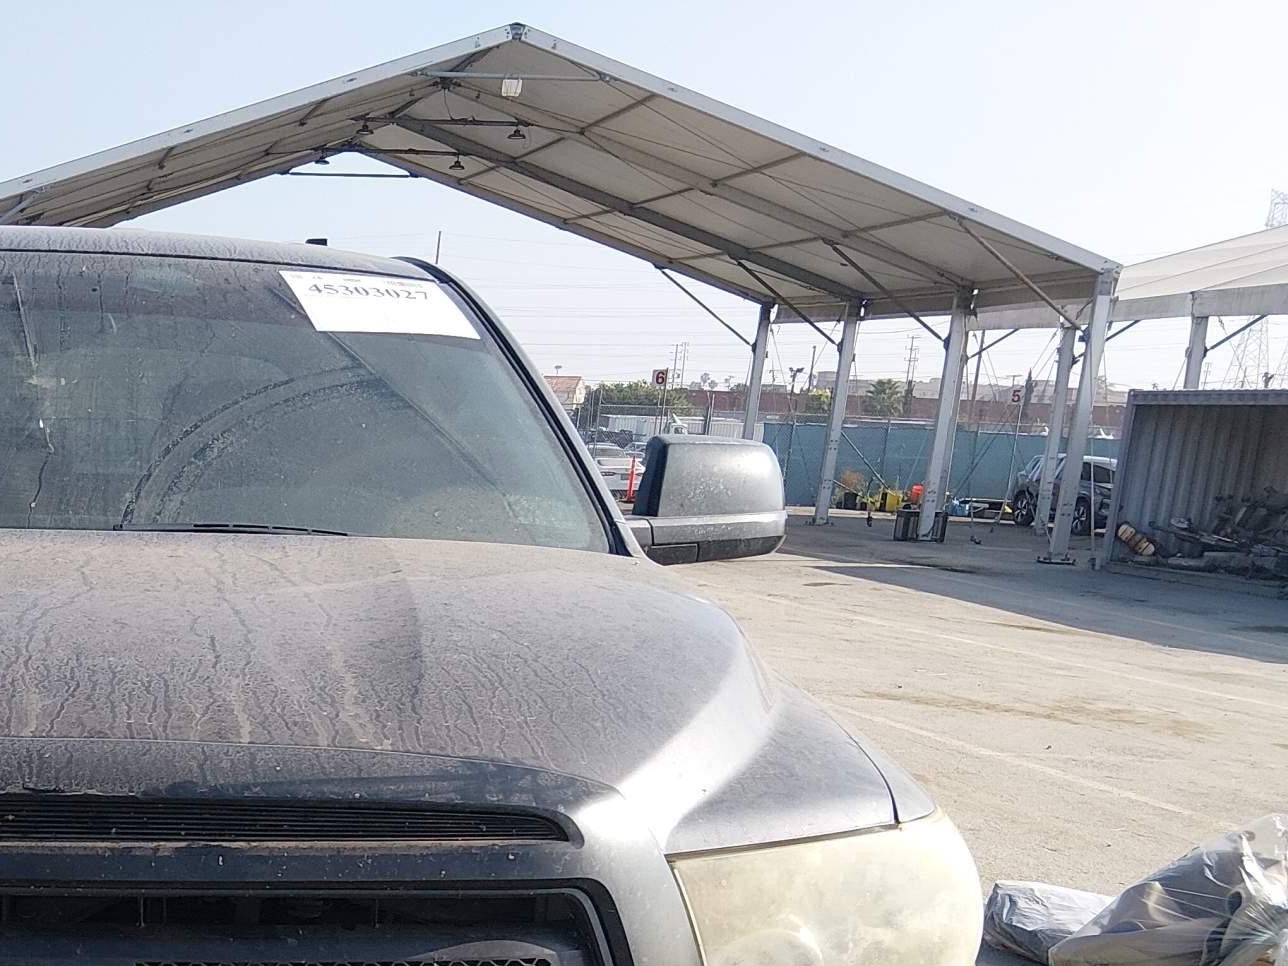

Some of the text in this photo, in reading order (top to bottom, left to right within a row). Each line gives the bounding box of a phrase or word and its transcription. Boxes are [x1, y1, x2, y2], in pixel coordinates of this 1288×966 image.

[308, 283, 429, 300] 45303027
[656, 371, 665, 384] 6
[1012, 390, 1022, 403] 5
